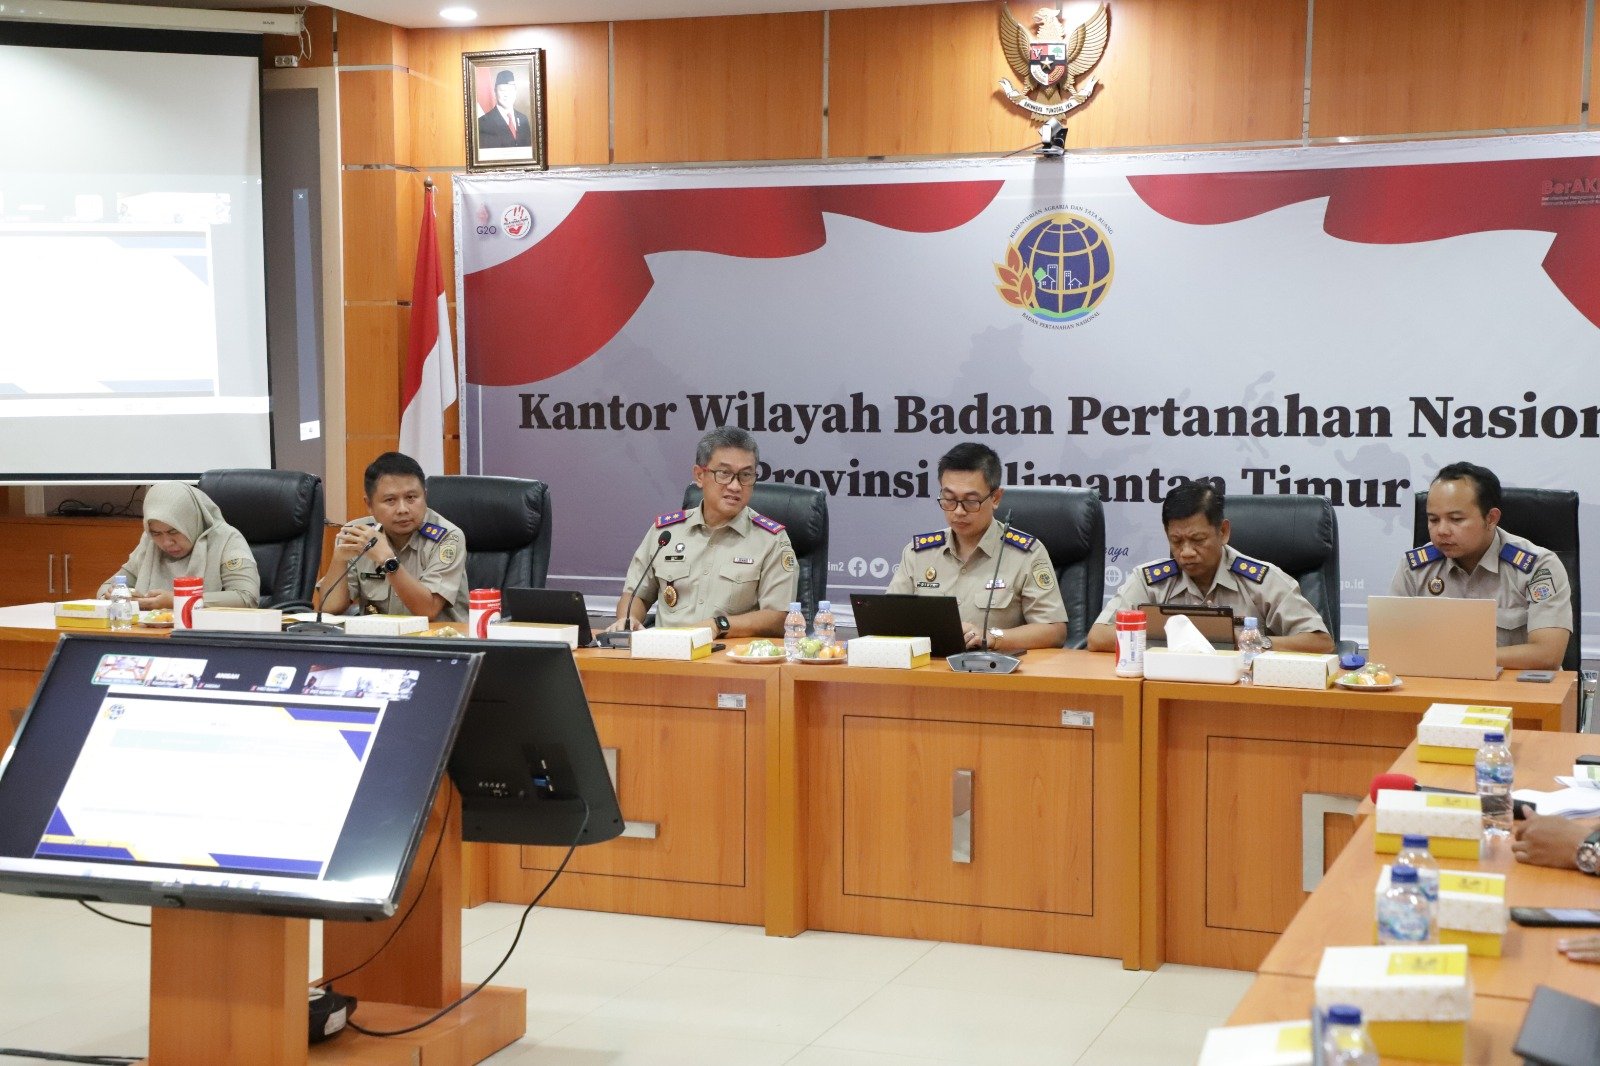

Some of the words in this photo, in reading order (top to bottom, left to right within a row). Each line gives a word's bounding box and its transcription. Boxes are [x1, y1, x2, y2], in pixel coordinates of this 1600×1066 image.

[1541, 177, 1600, 195] BerAK
[476, 225, 497, 235] G20
[1010, 208, 1043, 239] KEMENTERIAN
[1044, 204, 1069, 213] AGRARIA
[1070, 204, 1083, 212] DAN
[1085, 208, 1098, 220] TATA
[1099, 217, 1113, 235] RUANG
[1021, 312, 1039, 325] BADAN
[1039, 322, 1075, 330] PERTANAHAN
[1075, 311, 1100, 327] NASIONAL
[519, 393, 677, 431] Kantor
[686, 391, 881, 444] Wilayah
[894, 392, 1054, 435] Badan
[1067, 392, 1393, 438] Pertanahan
[1241, 464, 1411, 508] Timur
